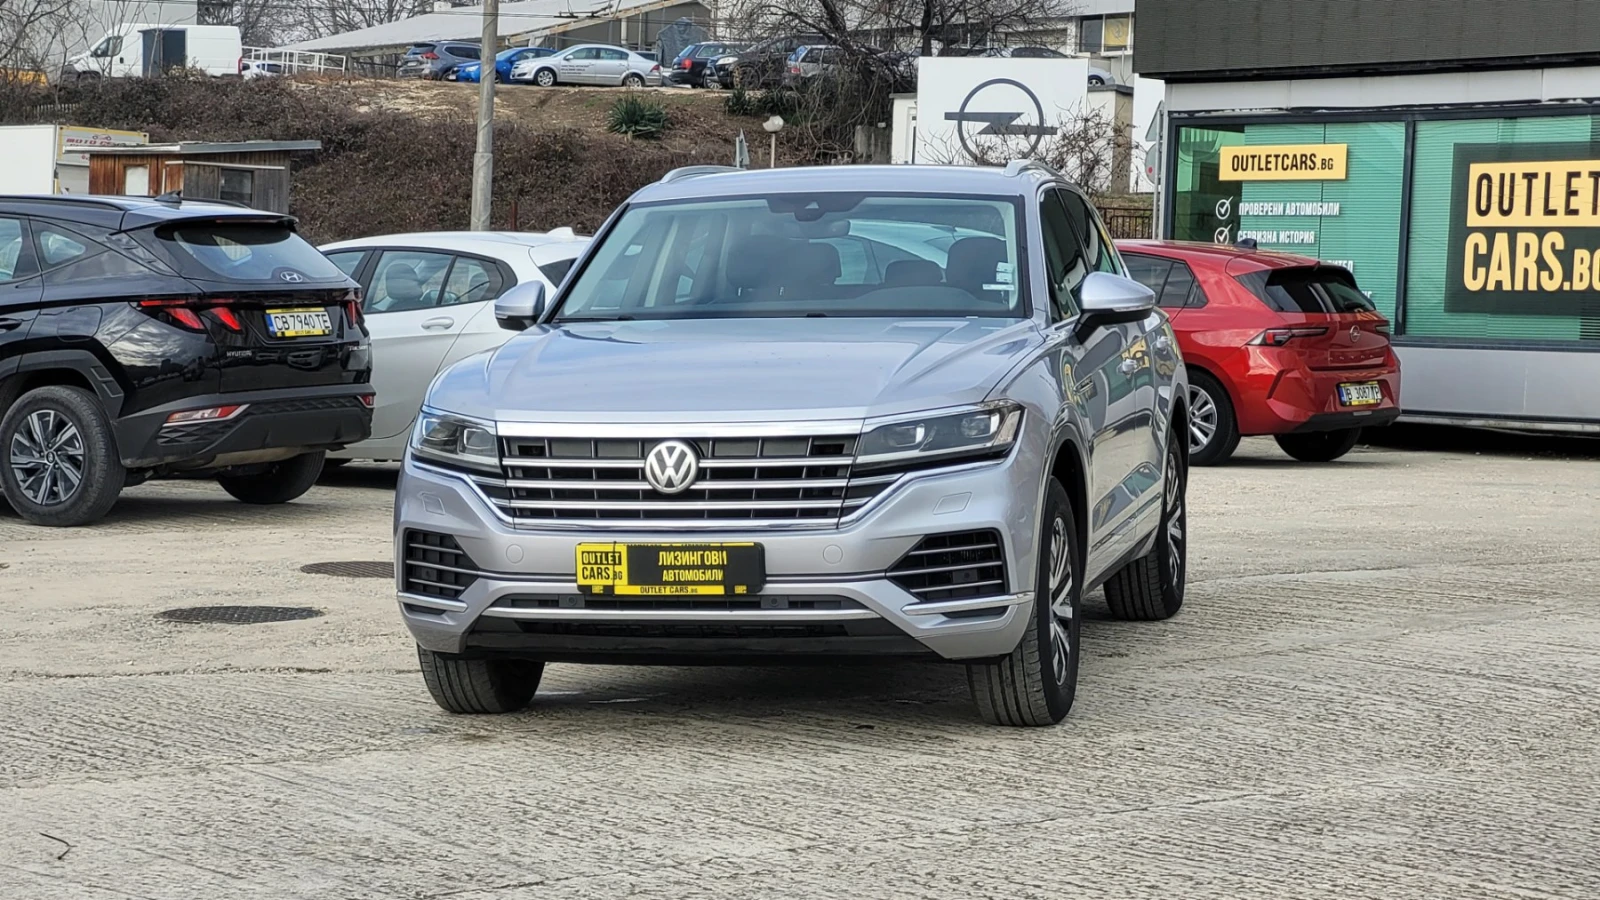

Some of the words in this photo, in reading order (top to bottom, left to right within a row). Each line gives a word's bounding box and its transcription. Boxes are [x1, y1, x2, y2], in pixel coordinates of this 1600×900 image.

[1231, 153, 1334, 172] OUTLETCARS.BG
[1475, 171, 1600, 217] OUTLET
[1238, 202, 1284, 216] ПРОВЕРЕНИ
[1284, 202, 1340, 216] АВТОМОБИЛИ
[1279, 230, 1315, 244] ИСТОРИЯ
[274, 315, 290, 331] CB
[290, 314, 315, 329] 7940
[315, 314, 331, 329] TE
[582, 552, 620, 564] OUTLET
[662, 569, 724, 581] АВТОМОБИЛИ
[640, 586, 667, 594] OUTLET
